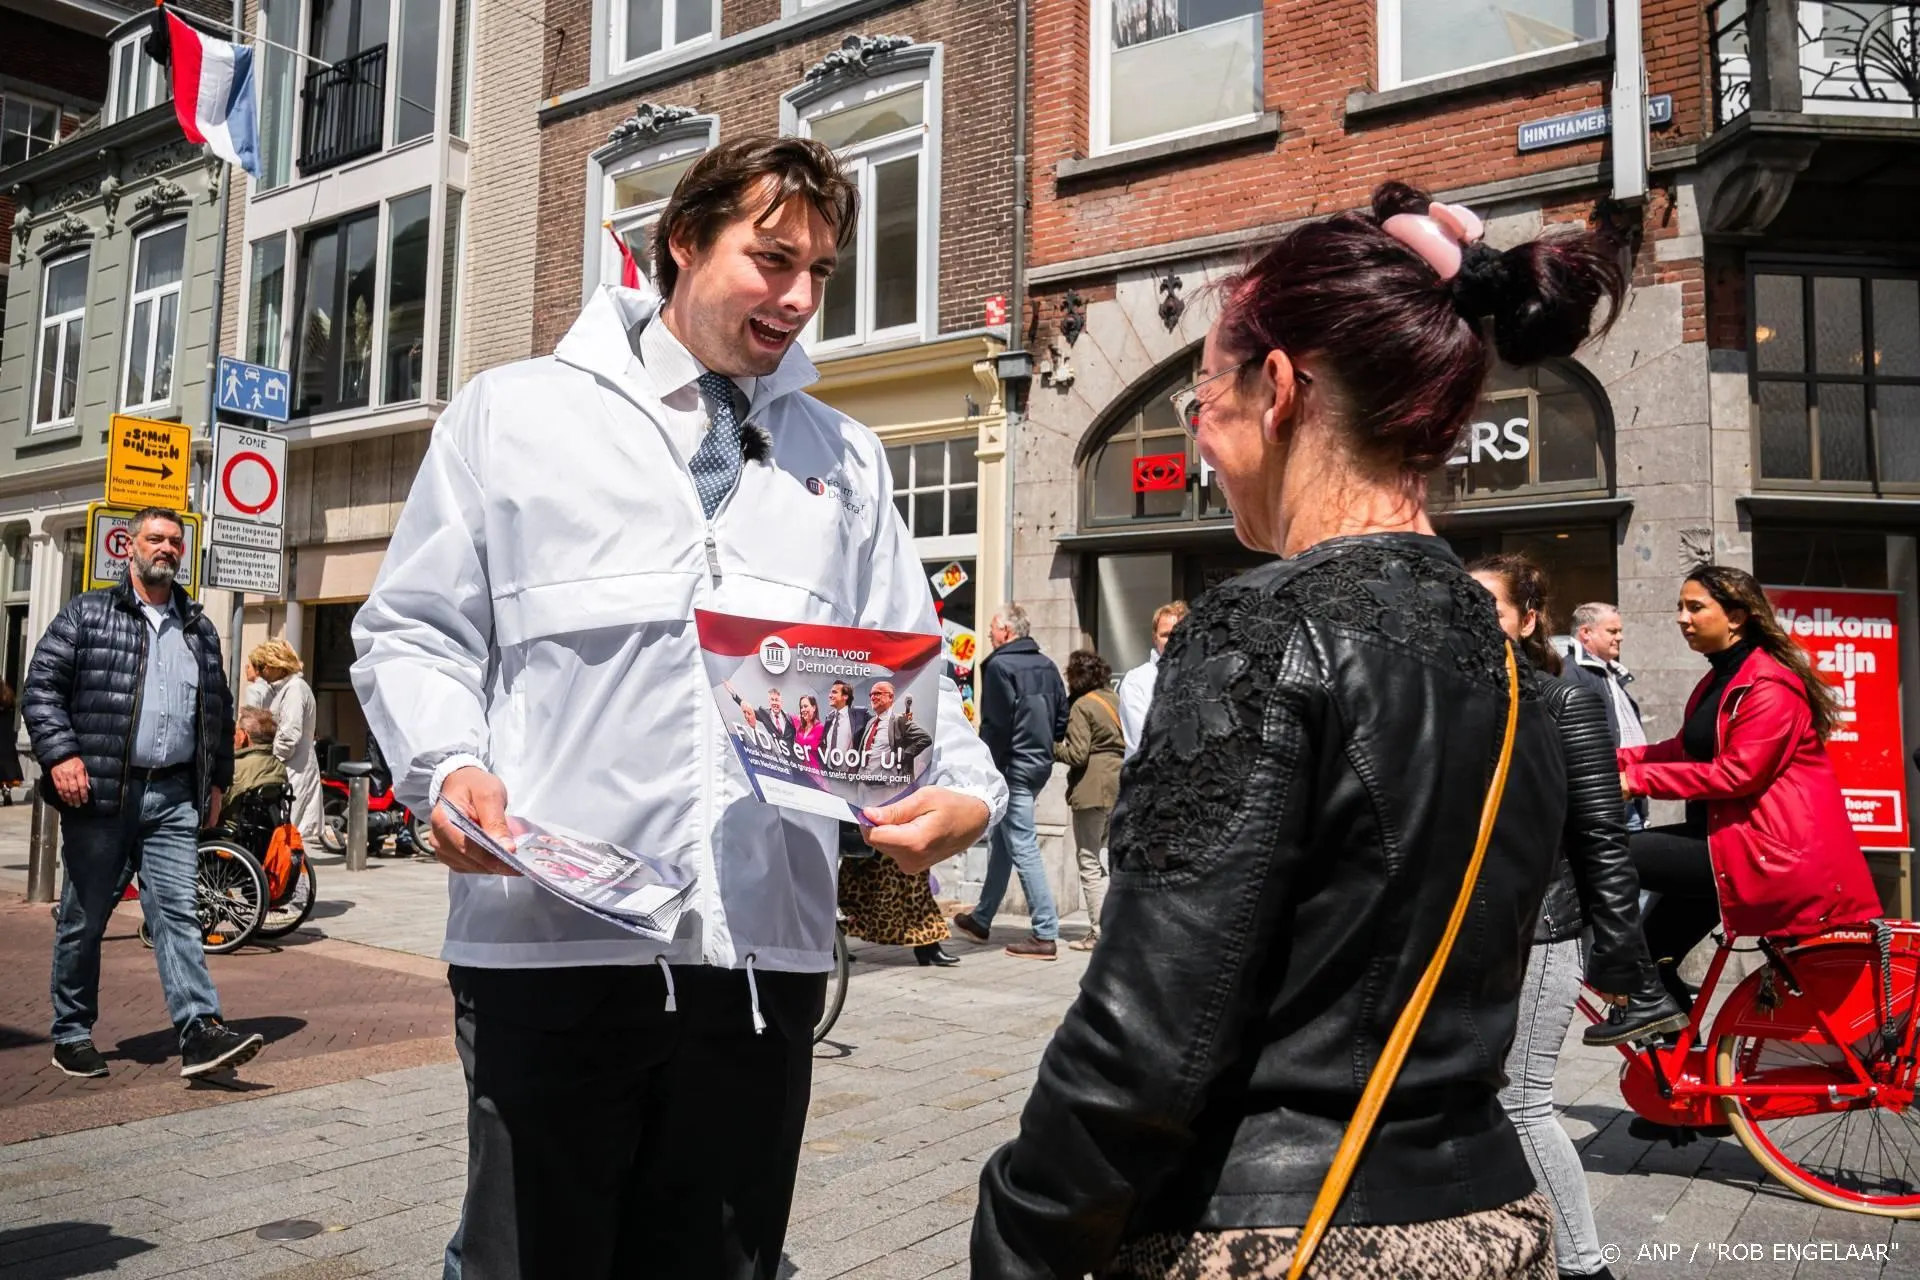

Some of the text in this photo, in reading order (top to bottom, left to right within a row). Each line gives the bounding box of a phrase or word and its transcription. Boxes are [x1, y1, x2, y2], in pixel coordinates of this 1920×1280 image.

[238, 435, 268, 449] ZONE
[222, 533, 258, 544] snorfietsen
[242, 527, 278, 538] toegestaan
[228, 550, 266, 560] uitgezonderd
[1775, 607, 1892, 639] Welkom
[797, 642, 871, 660] Forum voor
[796, 658, 871, 676] Democratie
[1816, 642, 1876, 679] zijn
[732, 721, 902, 770] FVD is er voor u!
[828, 770, 846, 780] snelst
[848, 772, 888, 782] groeiende
[890, 774, 910, 784] partij
[1844, 796, 1882, 810] hoor-
